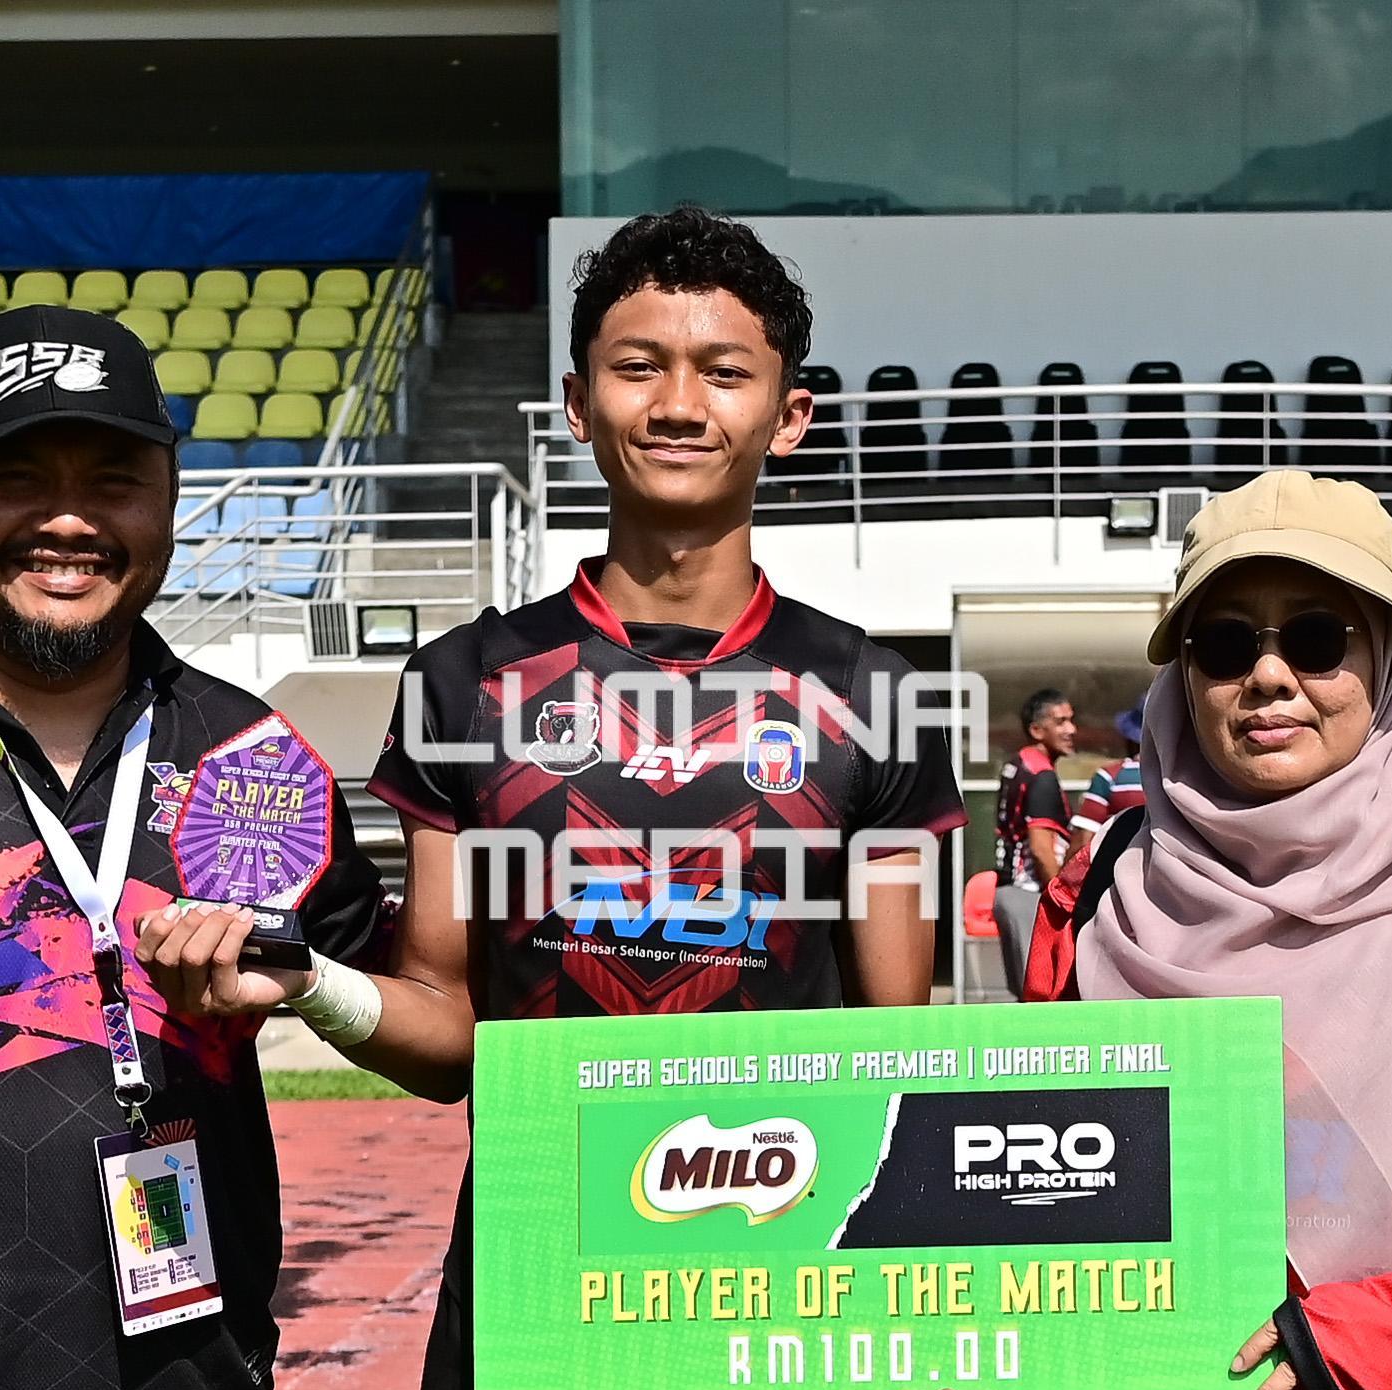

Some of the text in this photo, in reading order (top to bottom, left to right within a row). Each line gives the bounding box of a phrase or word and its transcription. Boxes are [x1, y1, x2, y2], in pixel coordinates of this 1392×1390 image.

[212, 803, 303, 824] OF THE MATCH
[216, 779, 304, 809] PLAYER
[532, 937, 768, 969] Menteri Besar Selangor (Incorporation)
[577, 1058, 651, 1089] SUPER
[660, 1055, 759, 1086] SCHOOLS
[766, 1052, 842, 1085] RUGBY
[851, 1048, 959, 1081] PREMIER
[983, 1046, 1091, 1080] QUARTER
[1100, 1043, 1172, 1073] FINAL
[660, 1146, 796, 1191] MILO
[953, 1122, 1116, 1173] PRO
[955, 1171, 1116, 1190] HIGH PROTEIN
[580, 1258, 1175, 1323] PLAYER OF THE MATCH
[728, 1330, 1020, 1385] RM100.00
